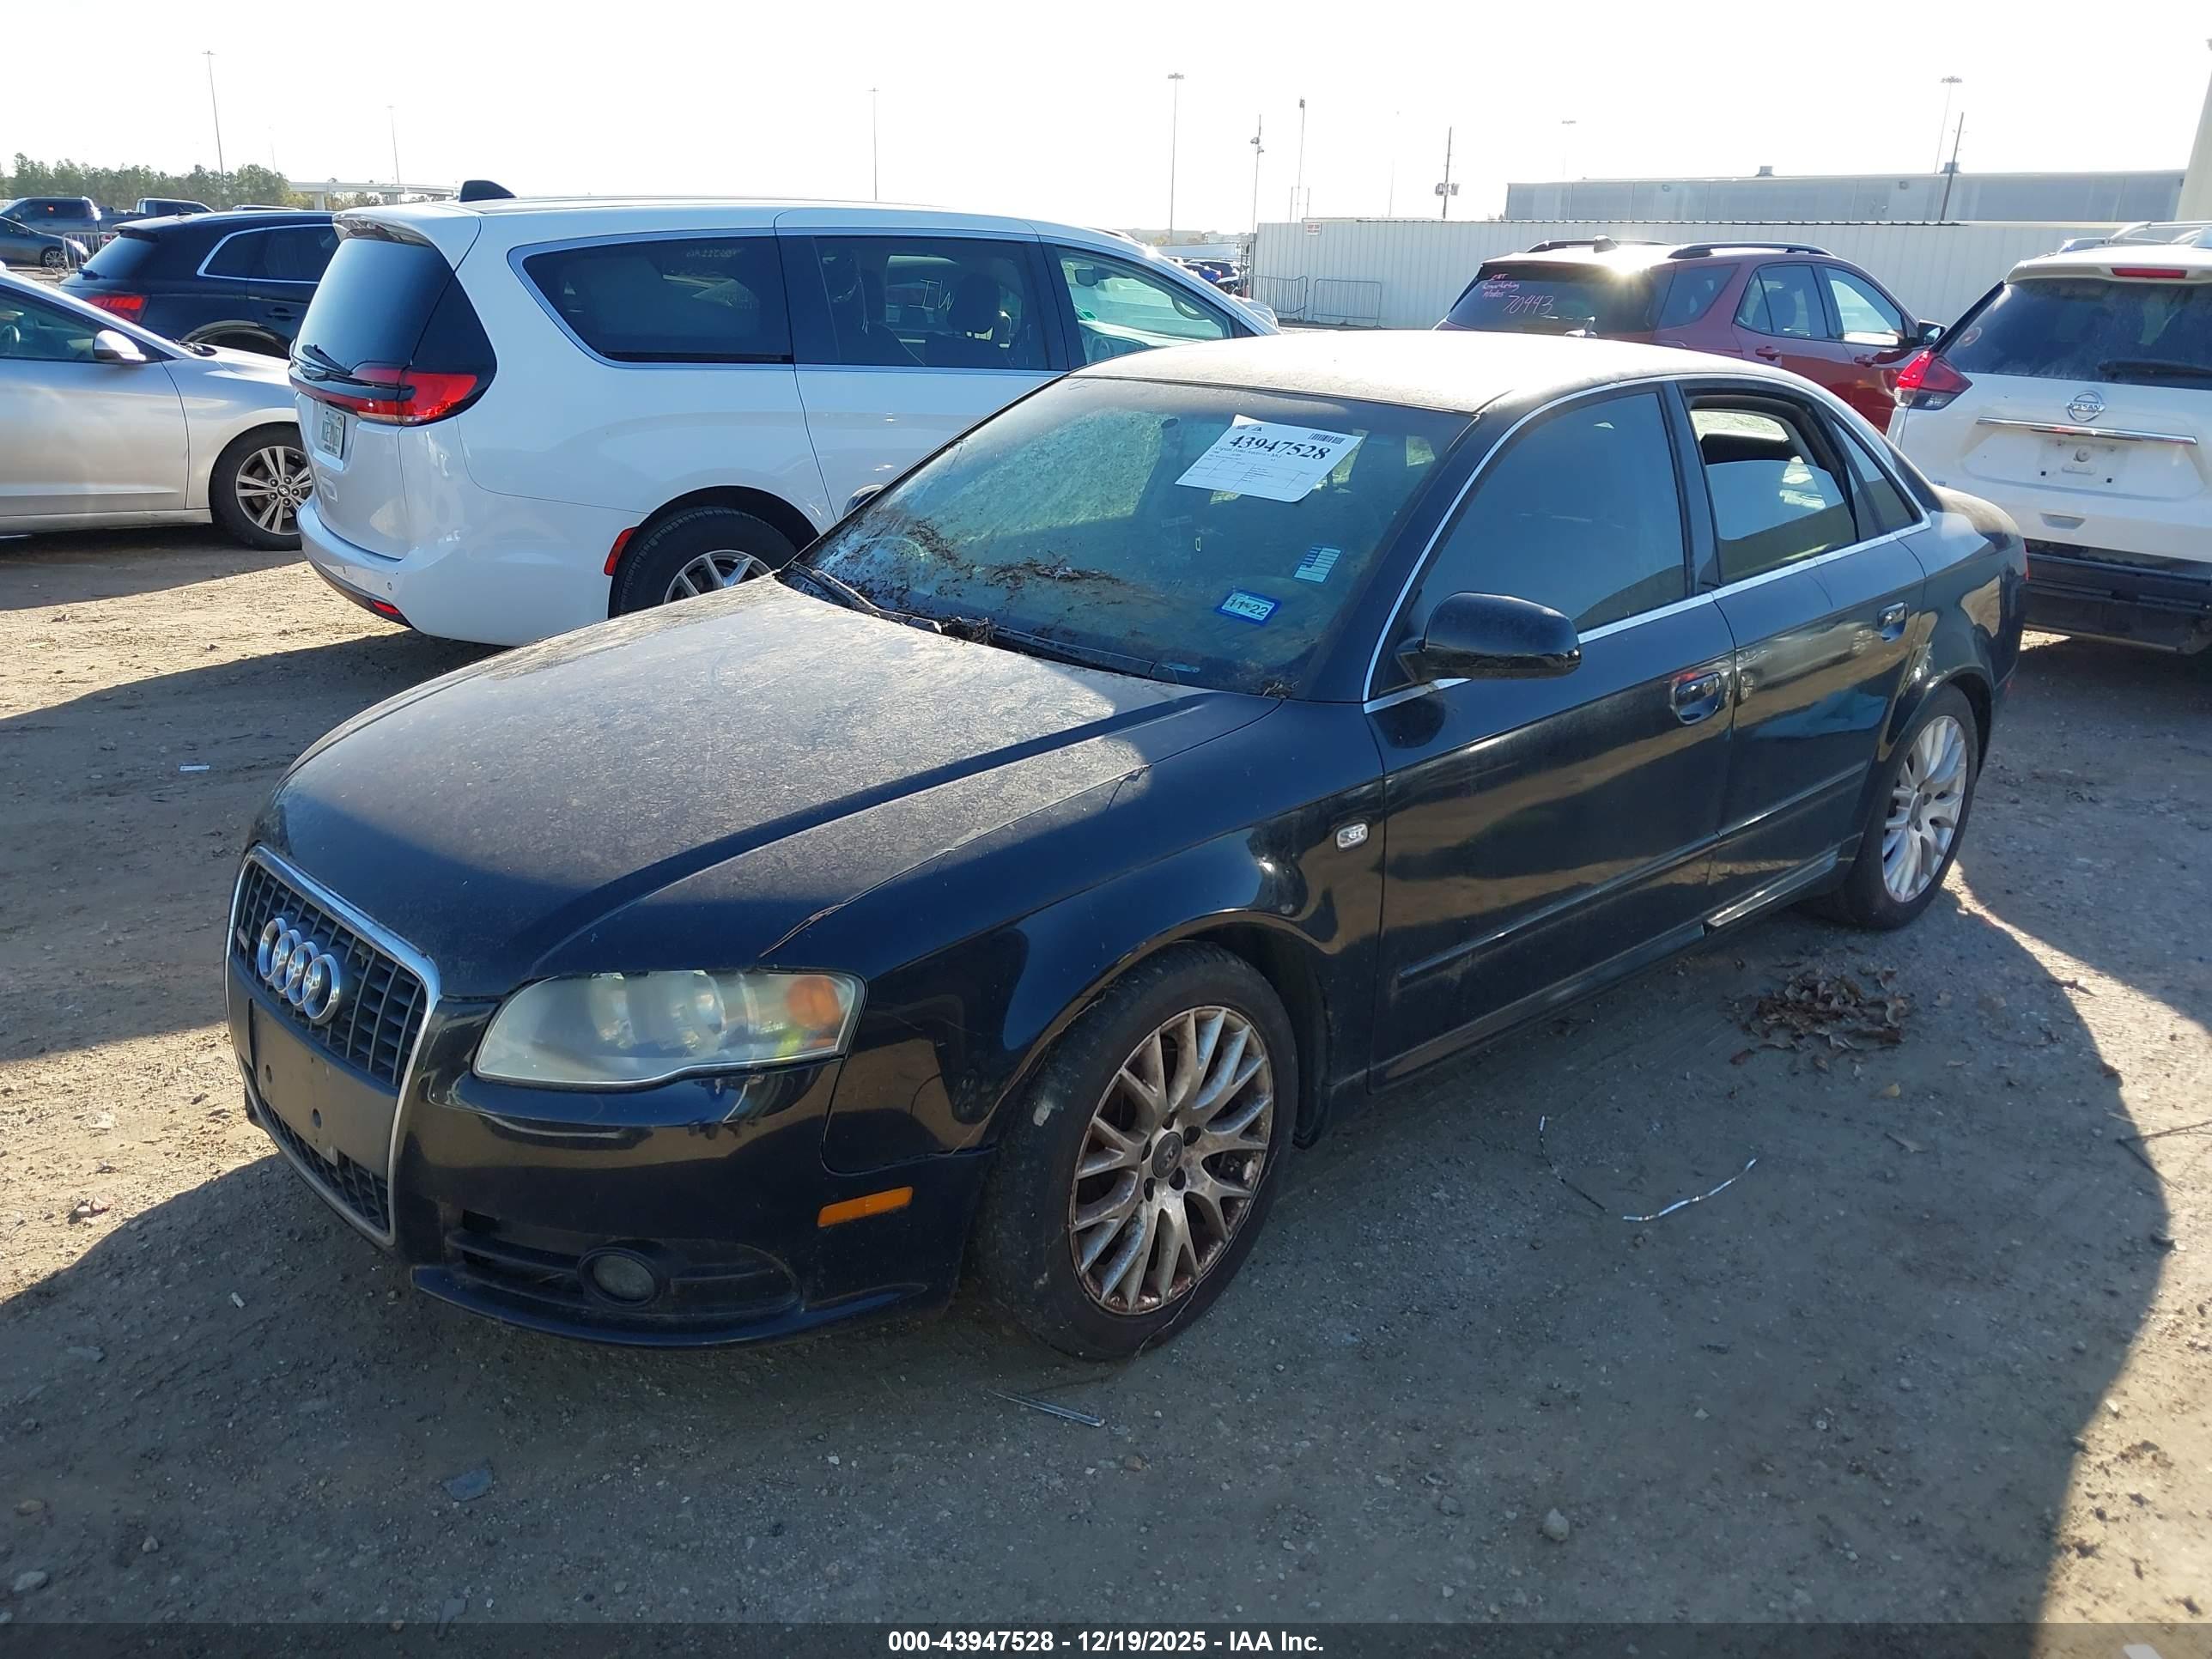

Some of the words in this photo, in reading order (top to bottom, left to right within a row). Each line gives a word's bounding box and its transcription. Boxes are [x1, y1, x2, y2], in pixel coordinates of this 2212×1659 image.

[1503, 295, 1554, 315] 70443
[2069, 402, 2100, 411] NISSAN
[1229, 434, 1331, 461] 43947528
[1249, 604, 1269, 617] 22
